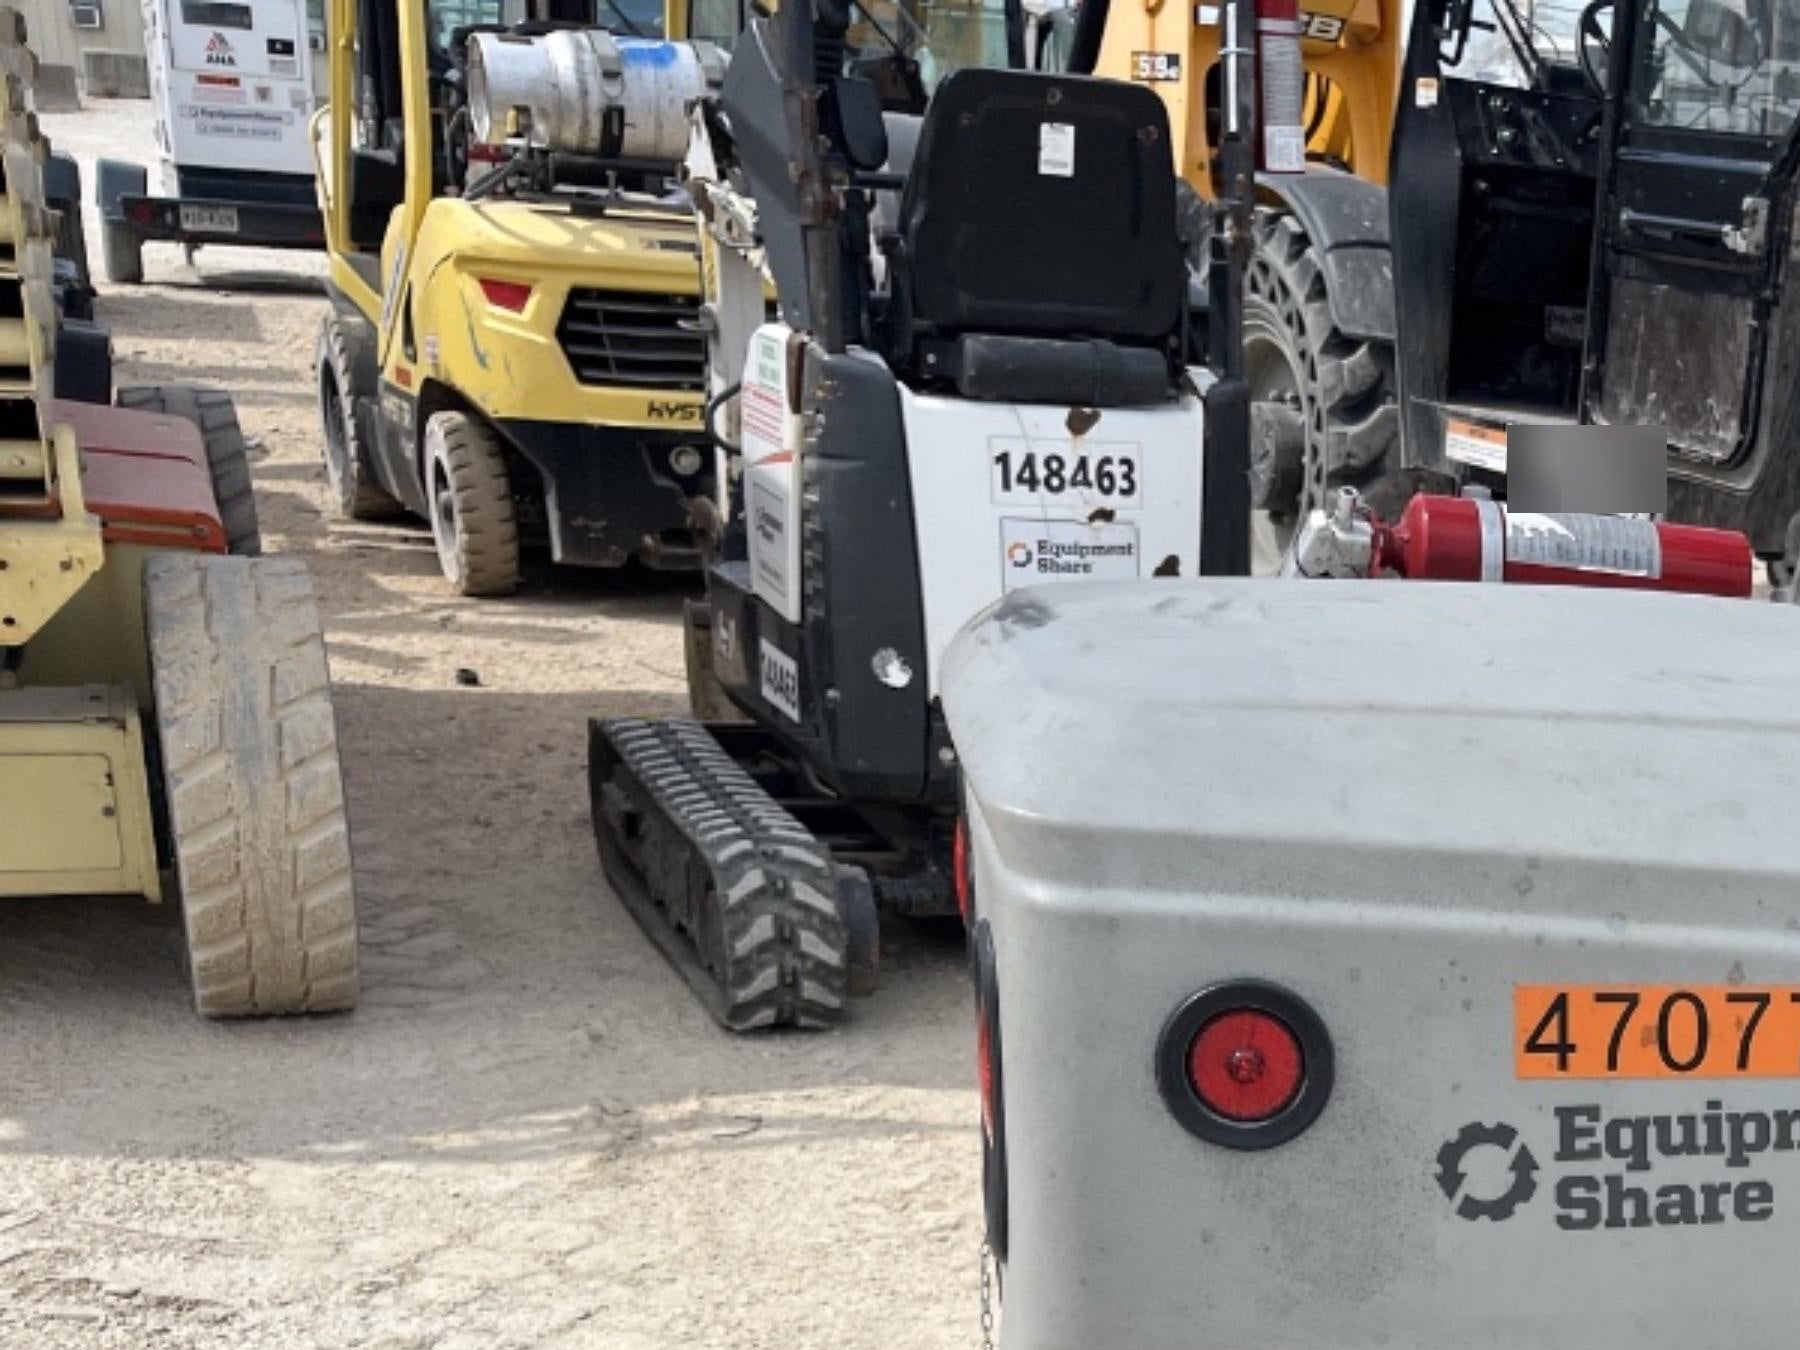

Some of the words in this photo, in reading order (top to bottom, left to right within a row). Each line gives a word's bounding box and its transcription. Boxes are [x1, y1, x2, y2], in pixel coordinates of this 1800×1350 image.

[994, 449, 1137, 497] 148463
[1036, 539, 1135, 559] Equipment
[1036, 557, 1093, 574] Share
[1554, 1174, 1775, 1231] Share
